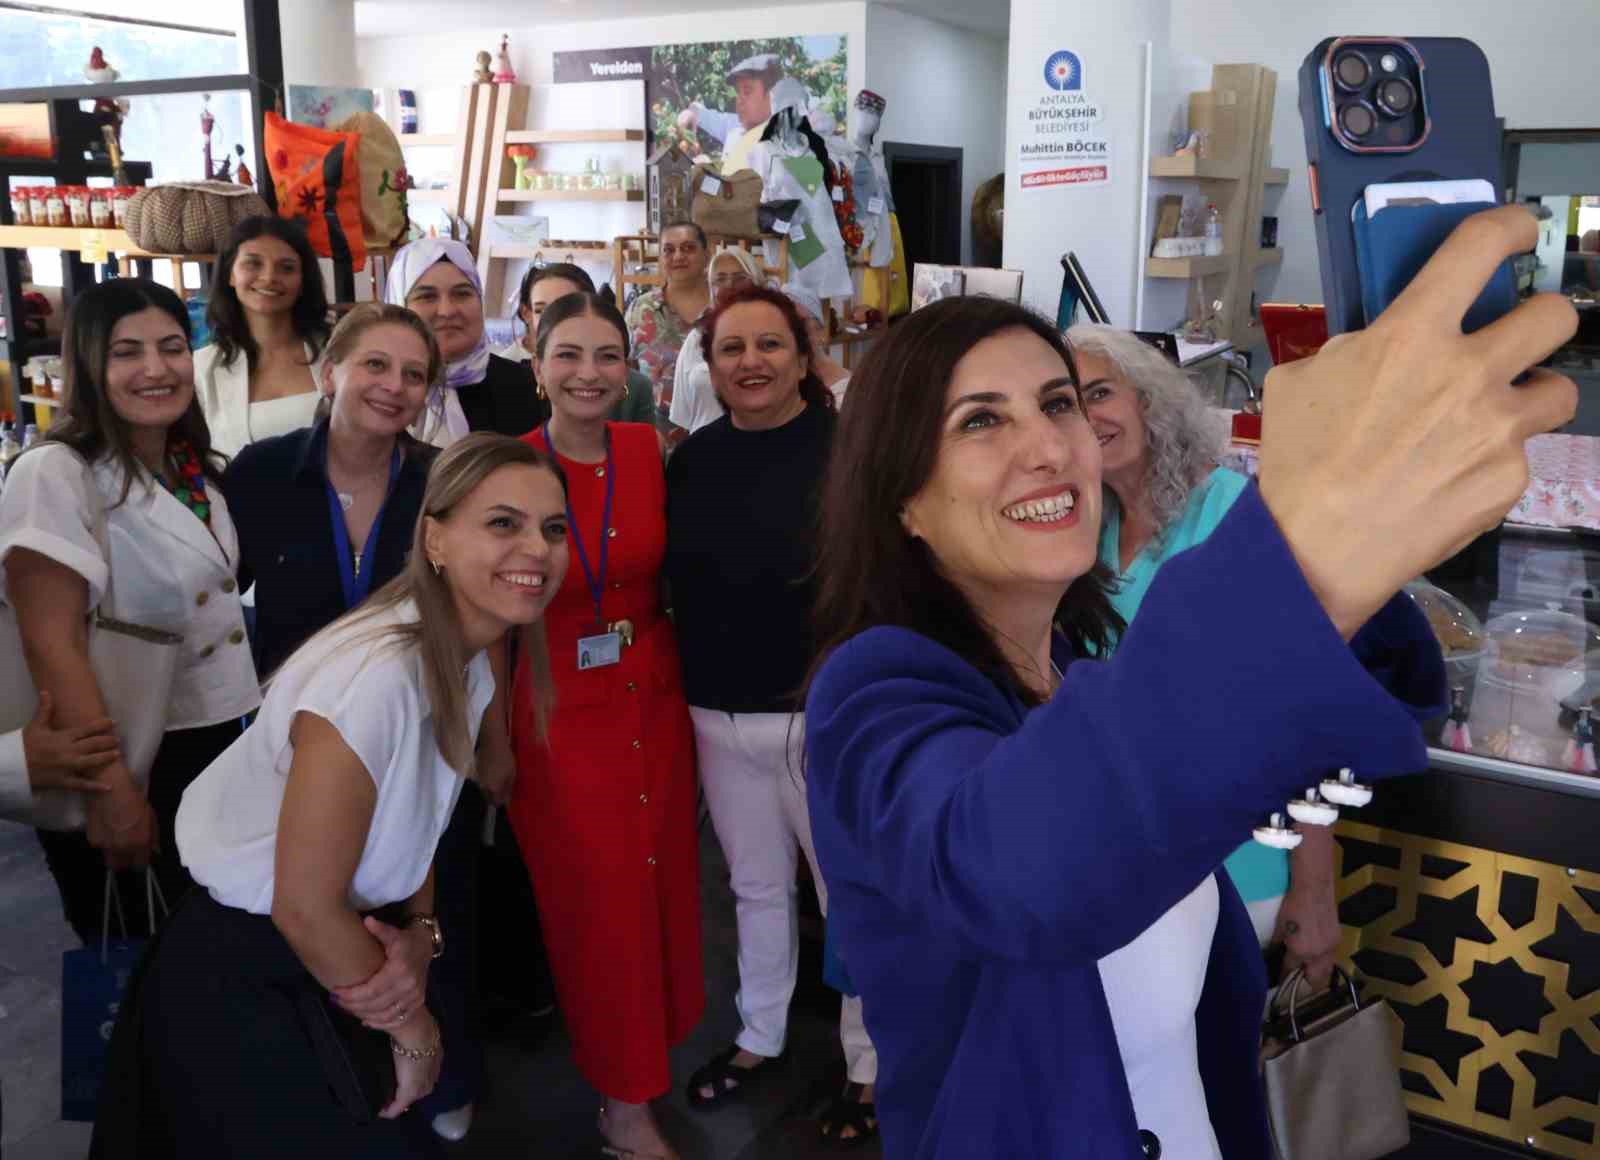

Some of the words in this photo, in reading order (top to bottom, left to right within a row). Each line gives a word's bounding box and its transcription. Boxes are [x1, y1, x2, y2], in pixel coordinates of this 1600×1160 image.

[589, 60, 643, 75] Yerelden
[1040, 94, 1085, 105] ANTALYA
[1021, 142, 1064, 153] Muhittin
[1066, 139, 1107, 152] BÖCEK
